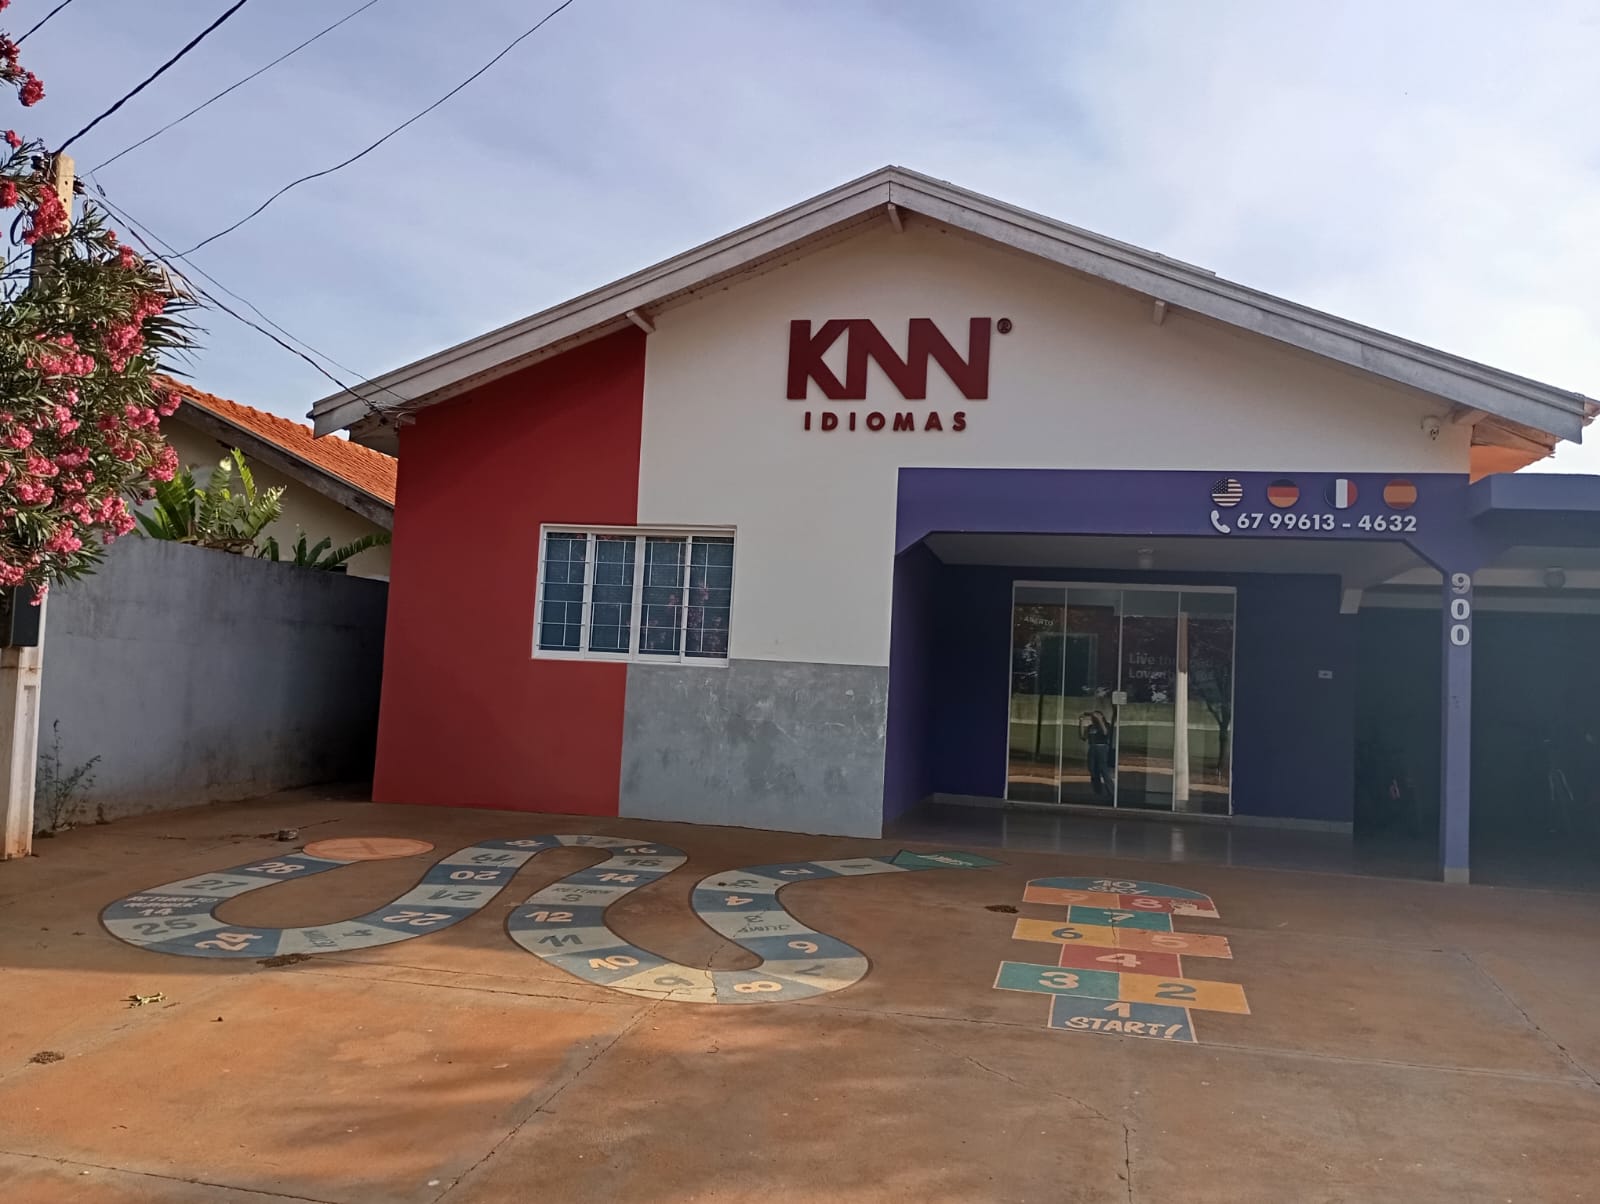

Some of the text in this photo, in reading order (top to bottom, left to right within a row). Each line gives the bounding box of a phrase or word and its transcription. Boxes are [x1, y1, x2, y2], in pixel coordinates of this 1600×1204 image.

[787, 317, 991, 400] KNN
[803, 411, 968, 431] IDIOMAS
[1236, 512, 1264, 529] 67
[1269, 513, 1336, 531] 99613
[1358, 514, 1418, 532] 4632
[1449, 572, 1472, 647] 900
[245, 861, 305, 874] 28
[623, 858, 661, 867] 15
[450, 870, 500, 881] 20
[596, 872, 639, 884] 14
[182, 879, 249, 891] 27
[1091, 880, 1137, 890] 10
[724, 895, 754, 907] 4
[1131, 898, 1162, 909] 8
[138, 908, 173, 916] 14
[383, 910, 452, 926] 22
[525, 911, 575, 923] 12
[1103, 911, 1136, 923] 7
[132, 918, 198, 936] 25
[1052, 927, 1084, 940] 6
[195, 932, 264, 952] 24
[1151, 935, 1190, 949] 5
[588, 955, 640, 971] 10
[1095, 953, 1142, 968] 4
[733, 980, 783, 994] 8
[1038, 971, 1080, 989] 3
[1155, 983, 1197, 1001] 2
[1103, 1002, 1131, 1018] 1
[1065, 1016, 1183, 1039] START!
